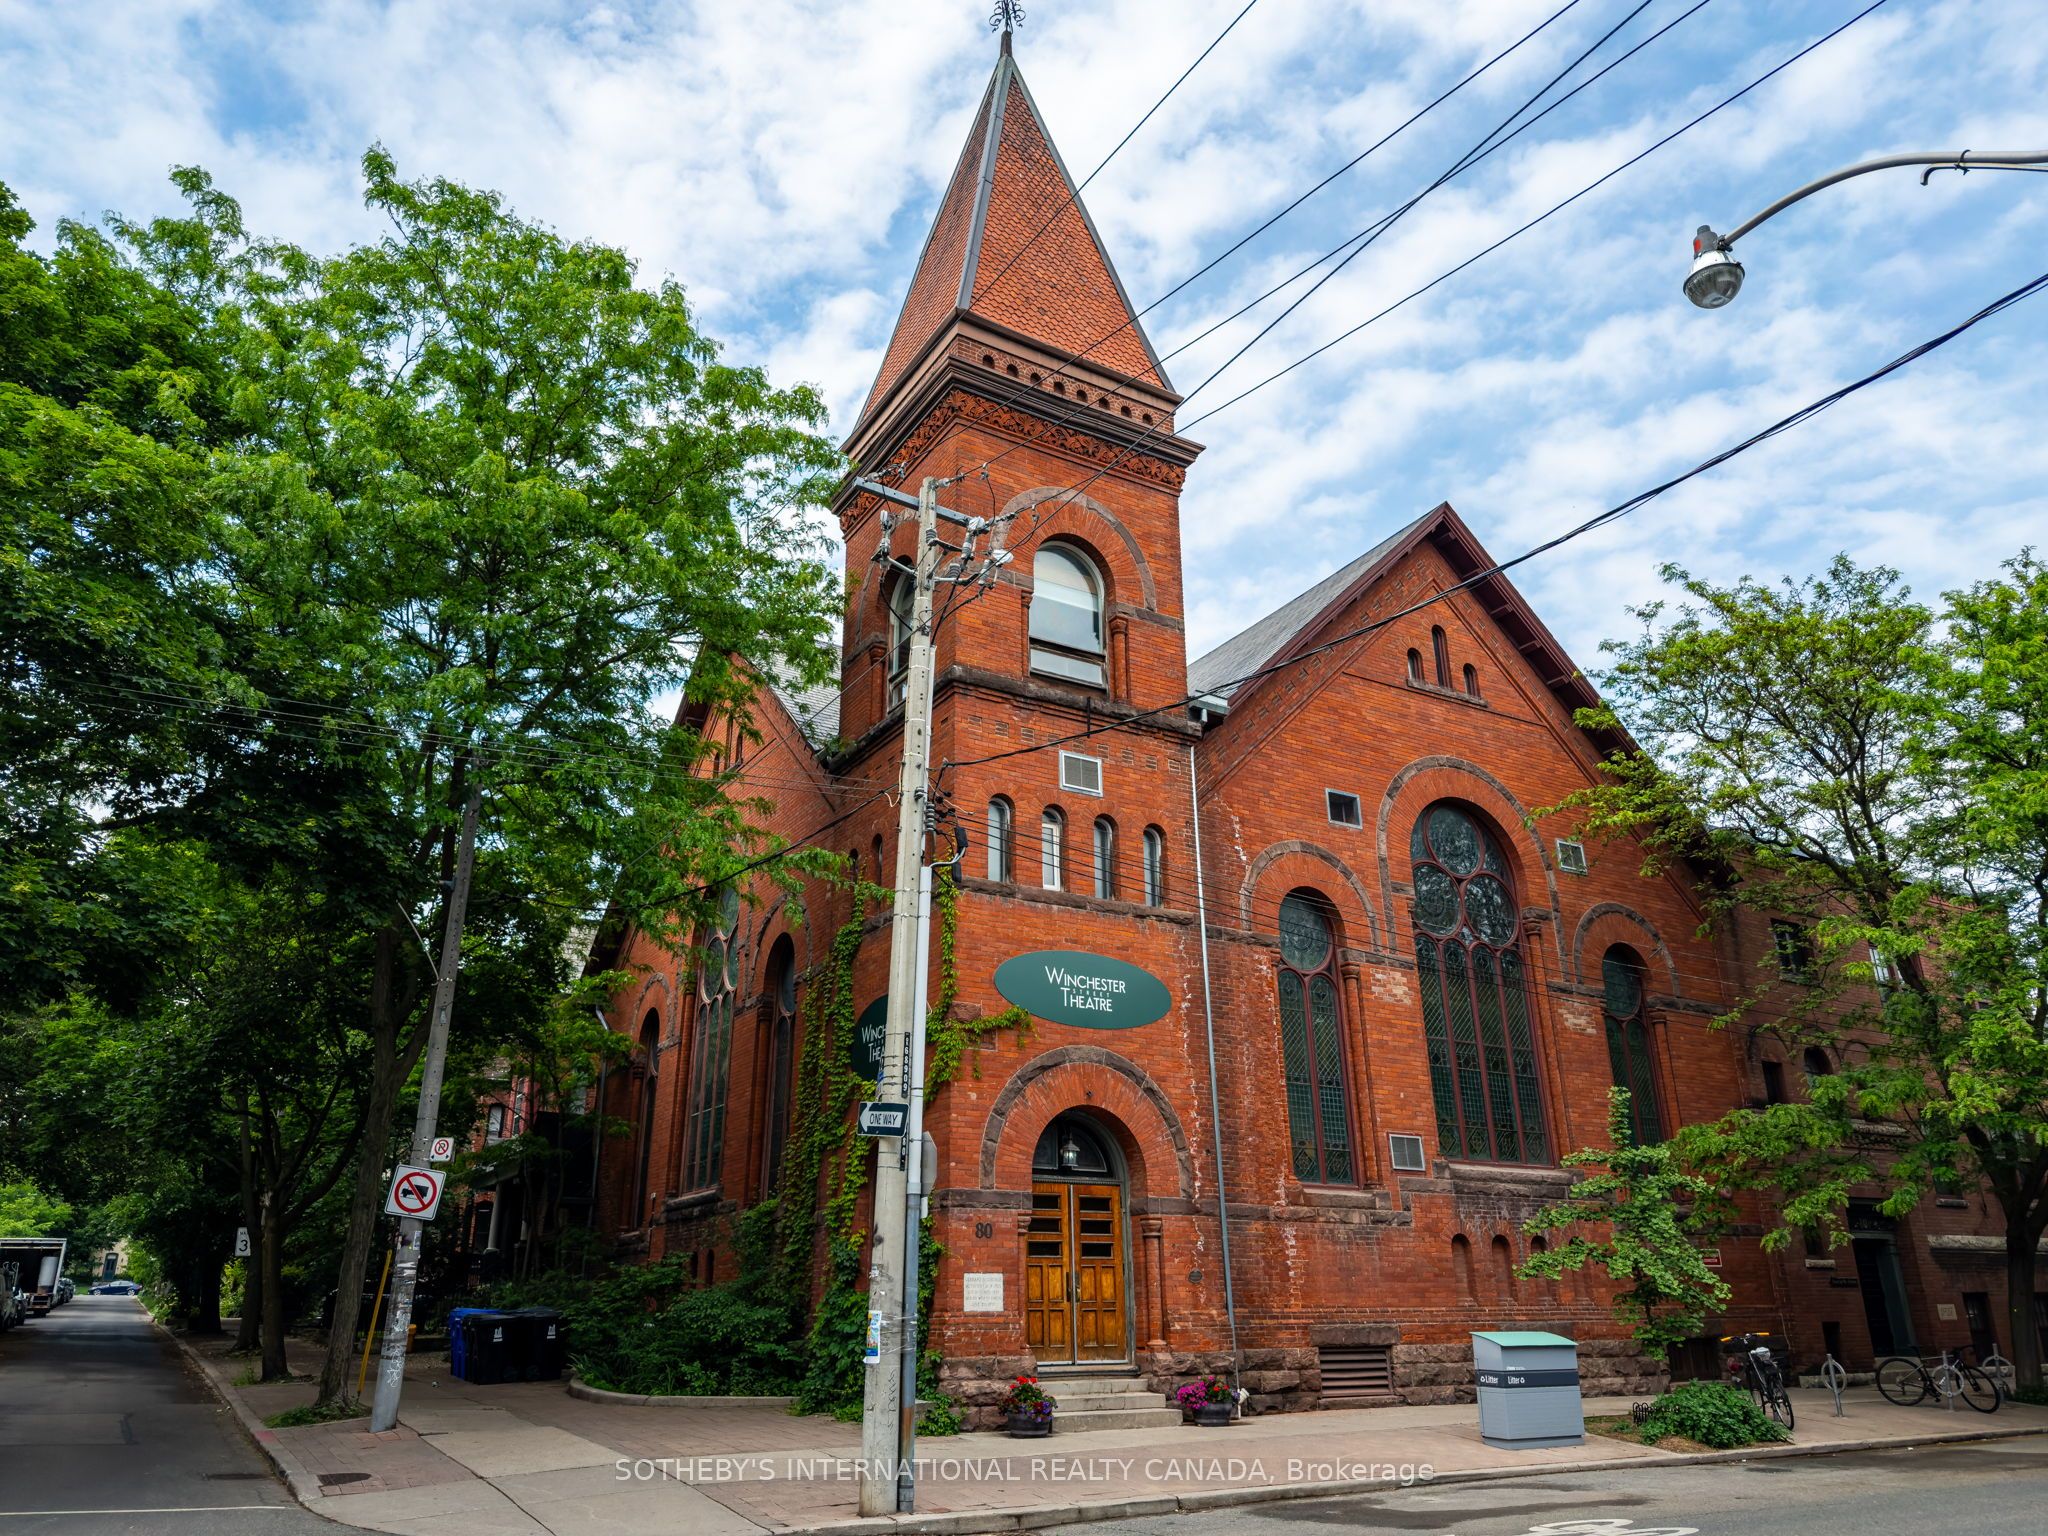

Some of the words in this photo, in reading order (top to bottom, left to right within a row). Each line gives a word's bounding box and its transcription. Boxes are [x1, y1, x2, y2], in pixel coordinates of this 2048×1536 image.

[1044, 965, 1126, 994] WINCHESTER
[1060, 987, 1113, 1012] THEATRE
[1072, 988, 1111, 998] STREET
[869, 1113, 882, 1125] ONE
[883, 1113, 898, 1126] WAY
[974, 1222, 993, 1239] 80
[1485, 1374, 1499, 1384] Litter
[1507, 1375, 1520, 1385] Litter
